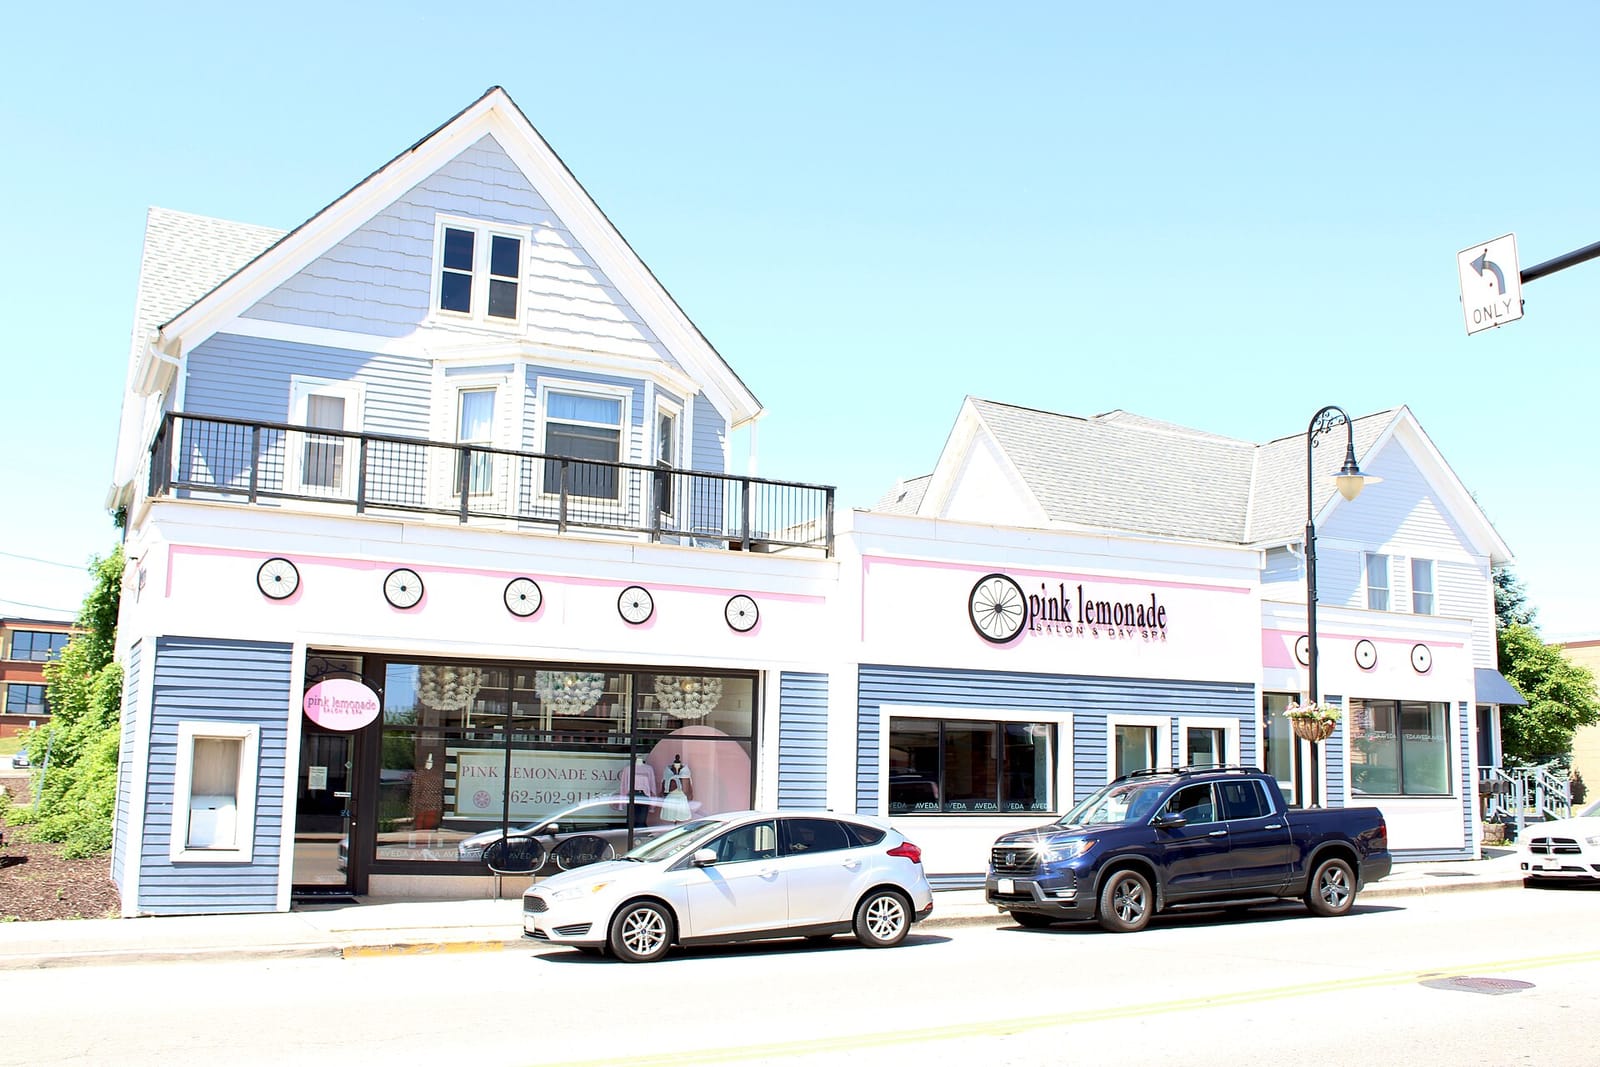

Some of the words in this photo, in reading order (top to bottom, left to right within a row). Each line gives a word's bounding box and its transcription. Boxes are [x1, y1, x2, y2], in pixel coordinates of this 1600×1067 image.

[1473, 298, 1512, 324] ONLY
[1028, 582, 1071, 630] pink
[1077, 584, 1167, 629] lemonade
[1036, 623, 1084, 635] SALON
[1108, 628, 1134, 638] DAY
[1141, 630, 1166, 640] SPA
[307, 695, 330, 708] pink
[332, 696, 377, 711] lemonade
[462, 765, 499, 778] PINK
[509, 766, 588, 781] EMONADE
[1030, 802, 1049, 810] AVED
